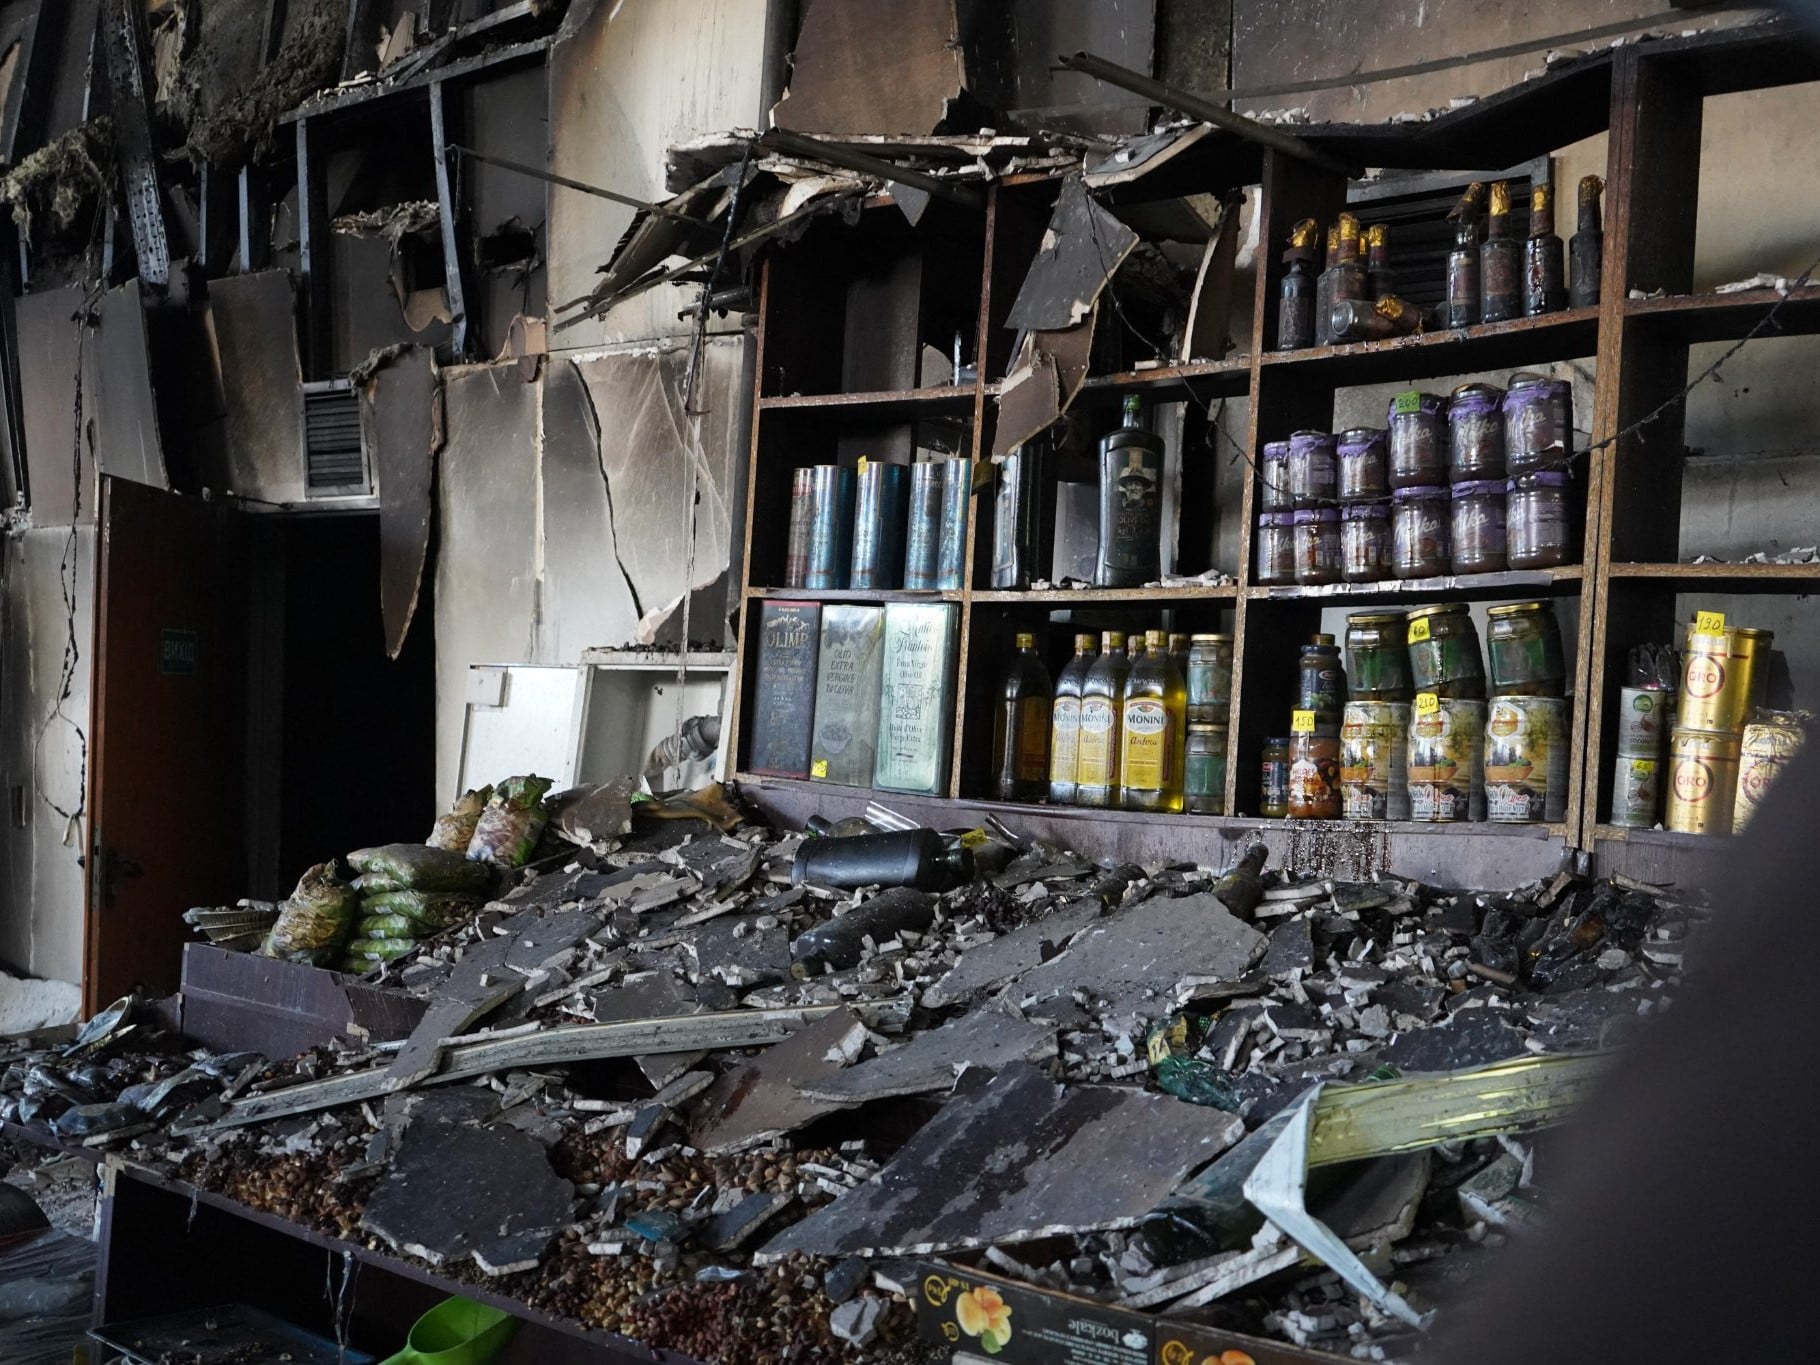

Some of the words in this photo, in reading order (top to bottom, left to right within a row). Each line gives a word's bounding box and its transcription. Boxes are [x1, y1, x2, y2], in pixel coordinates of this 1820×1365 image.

[830, 661, 855, 671] EXTRA
[1418, 697, 1436, 709] 210
[1128, 714, 1164, 725] MONINI
[1294, 715, 1314, 727] 150
[1677, 775, 1706, 787] ORO
[1067, 1319, 1120, 1344] bozkale
